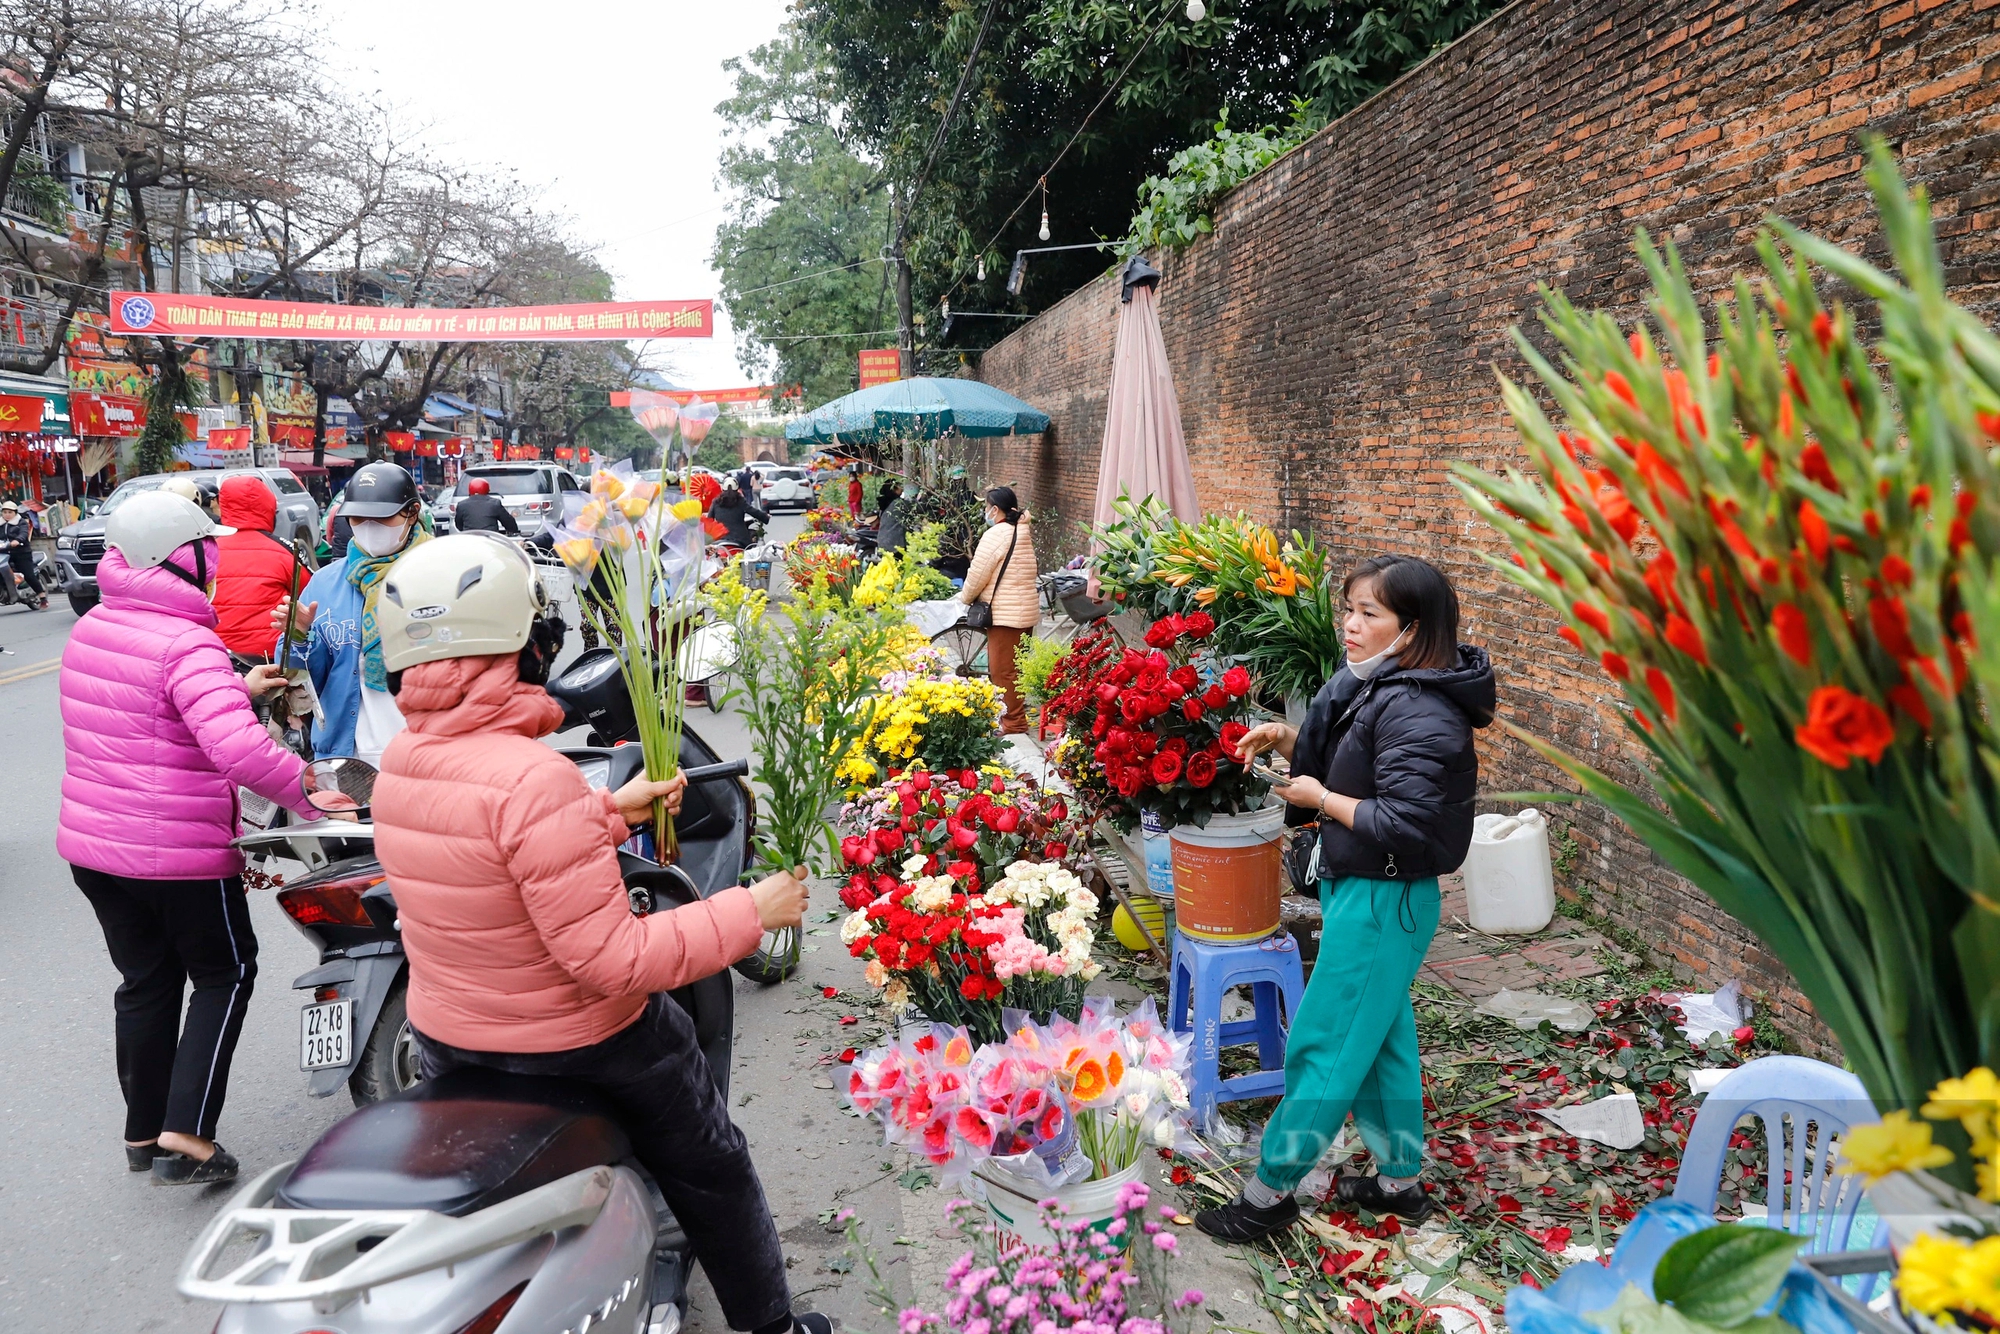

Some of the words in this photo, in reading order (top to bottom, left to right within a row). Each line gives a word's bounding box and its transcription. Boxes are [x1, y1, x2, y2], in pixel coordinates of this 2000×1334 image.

[167, 304, 197, 325] TOÀN
[199, 306, 223, 326] DÂN
[226, 309, 258, 328] THAM
[260, 311, 278, 328] GIA
[281, 308, 304, 329] BẢO
[306, 309, 335, 330] HIỂM
[337, 313, 352, 331] XÃ
[355, 314, 376, 334] HỘI,
[379, 313, 402, 332] BẢO
[403, 313, 432, 332] HIỂM
[435, 318, 442, 332] Y
[444, 314, 459, 332] TẾ
[467, 315, 477, 332] VÌ
[479, 316, 496, 335] LỢI
[498, 315, 517, 332] ÍCH
[519, 312, 541, 331] BẢN
[544, 312, 575, 332] THÂN,
[577, 314, 595, 329] GIA
[598, 311, 623, 329] ĐÌNH
[626, 309, 639, 329] VÀ
[642, 308, 671, 332] CỘNG
[308, 1034, 343, 1066] 2969
